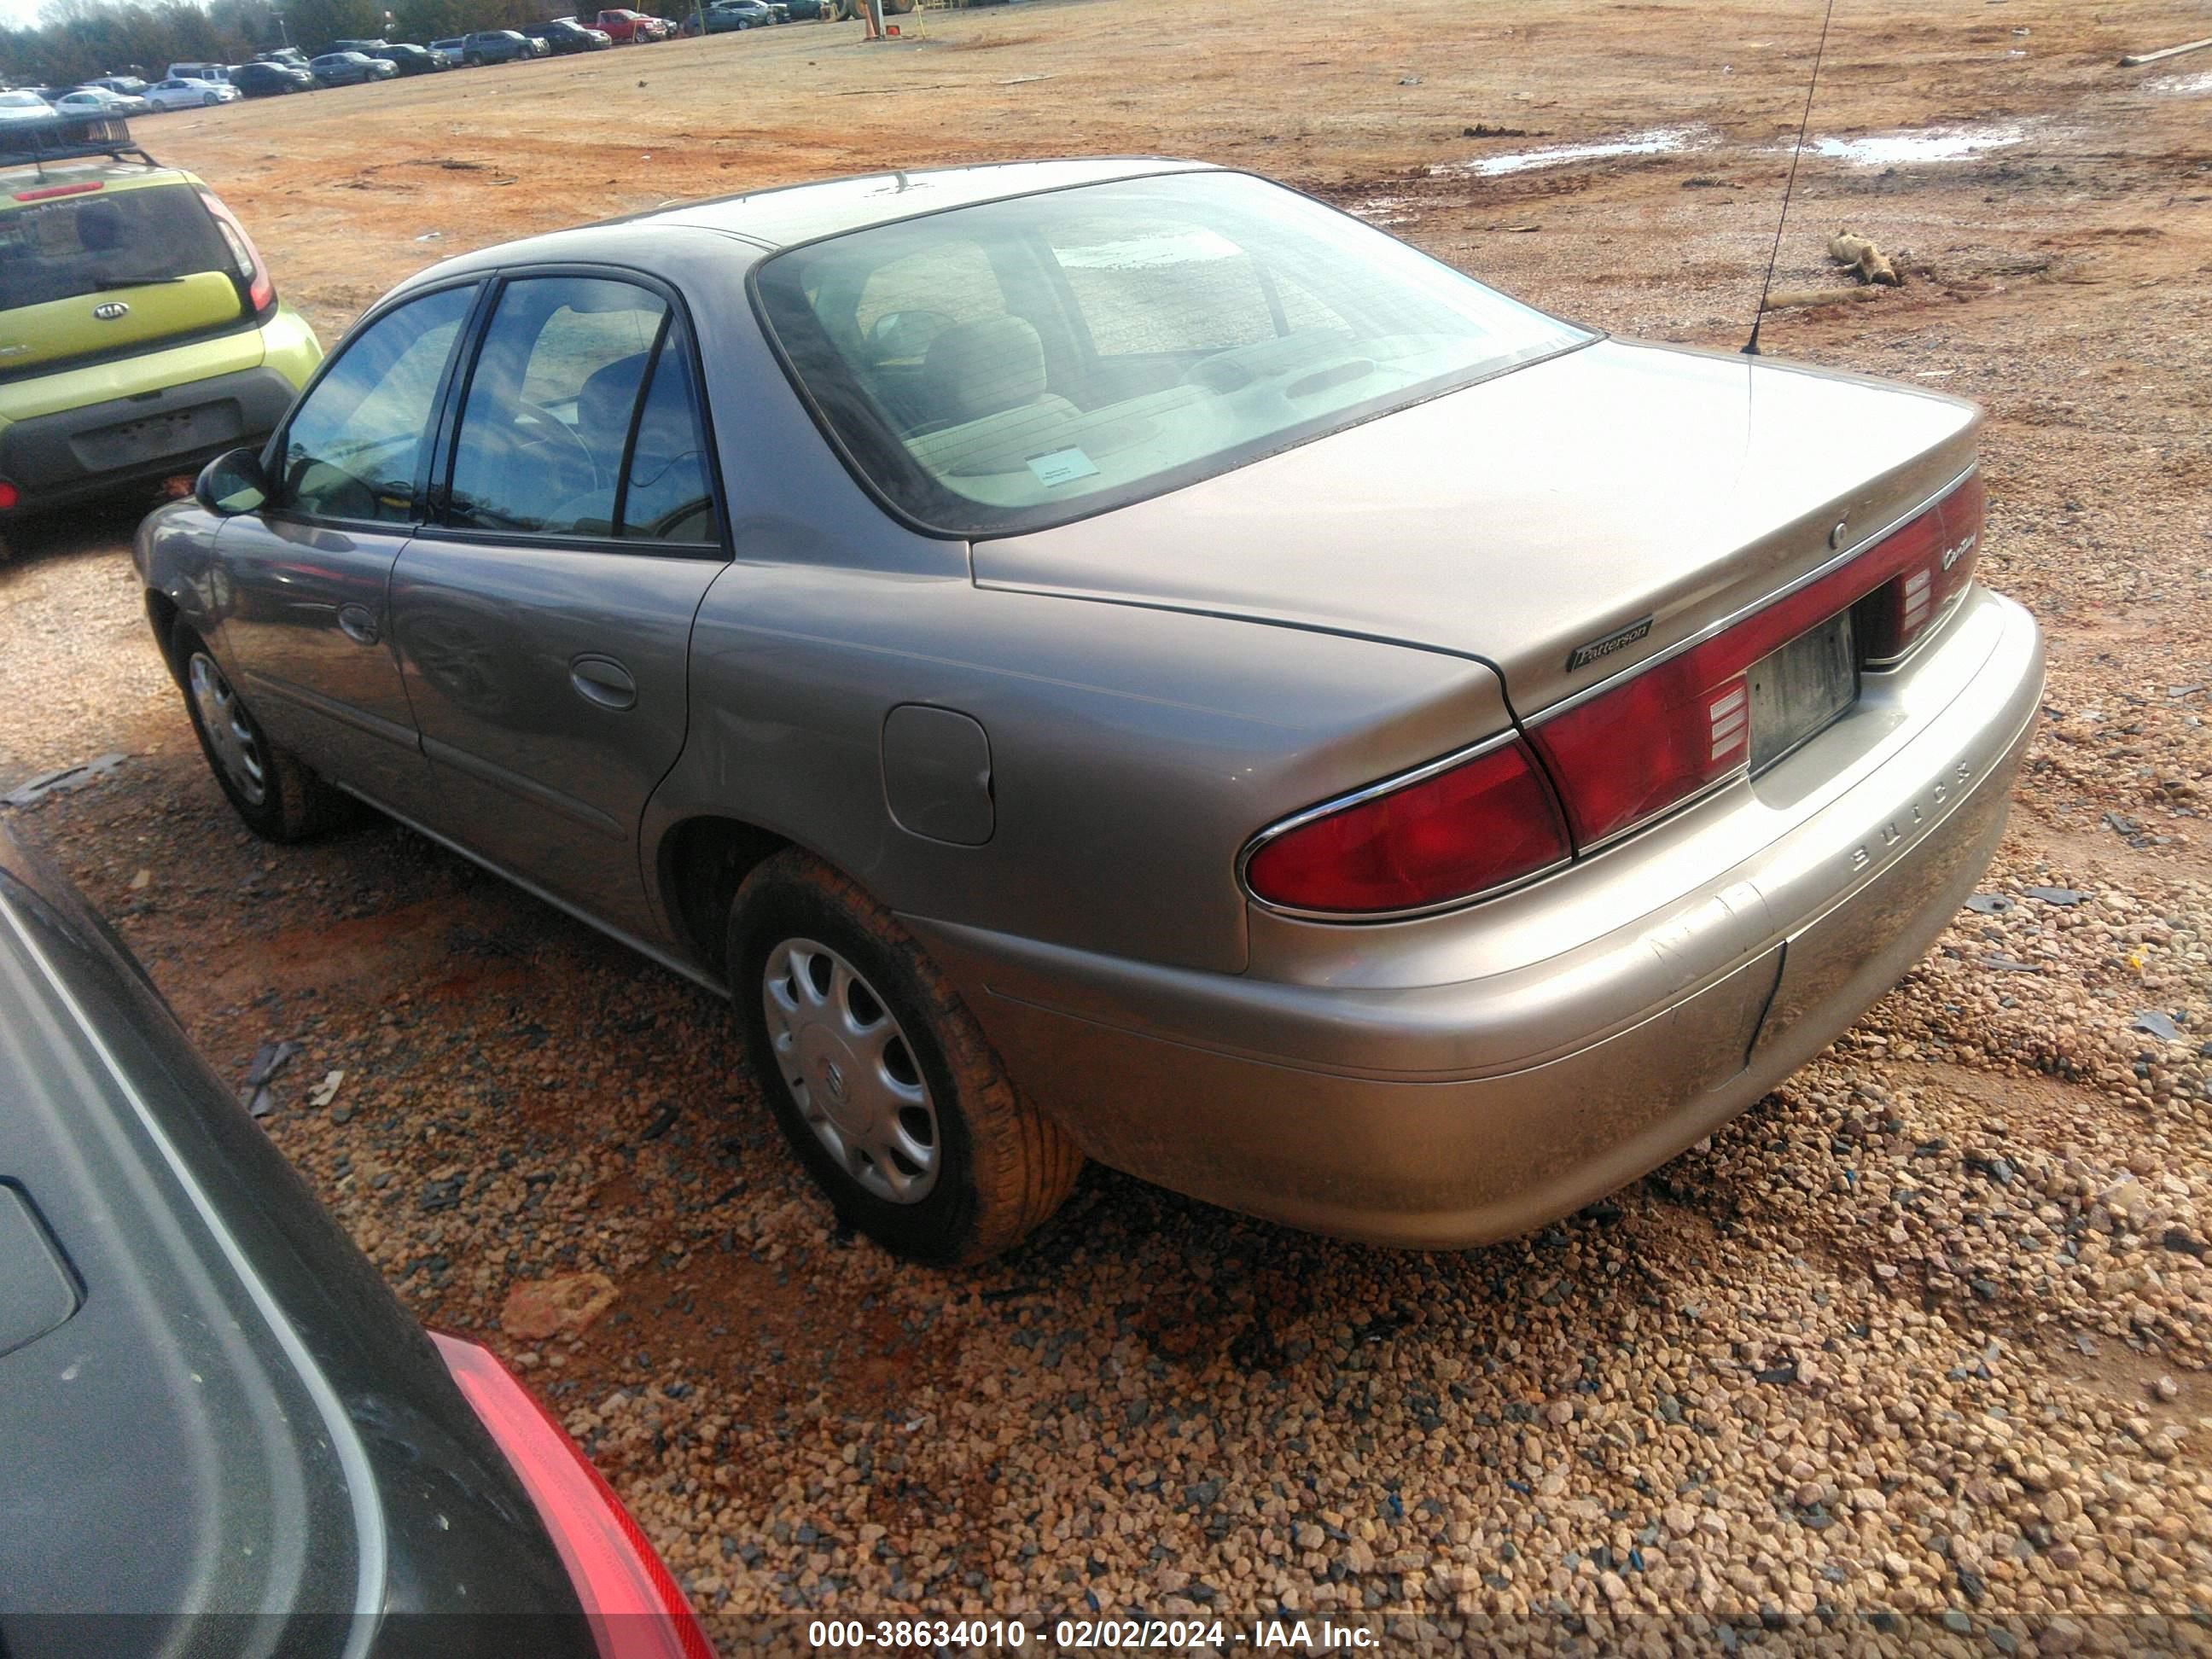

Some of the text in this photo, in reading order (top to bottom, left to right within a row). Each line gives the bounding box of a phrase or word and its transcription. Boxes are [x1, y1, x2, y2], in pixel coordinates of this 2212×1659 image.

[96, 303, 125, 319] KIA
[1577, 626, 1647, 665] Patterson
[1849, 760, 1970, 872] BUICK
